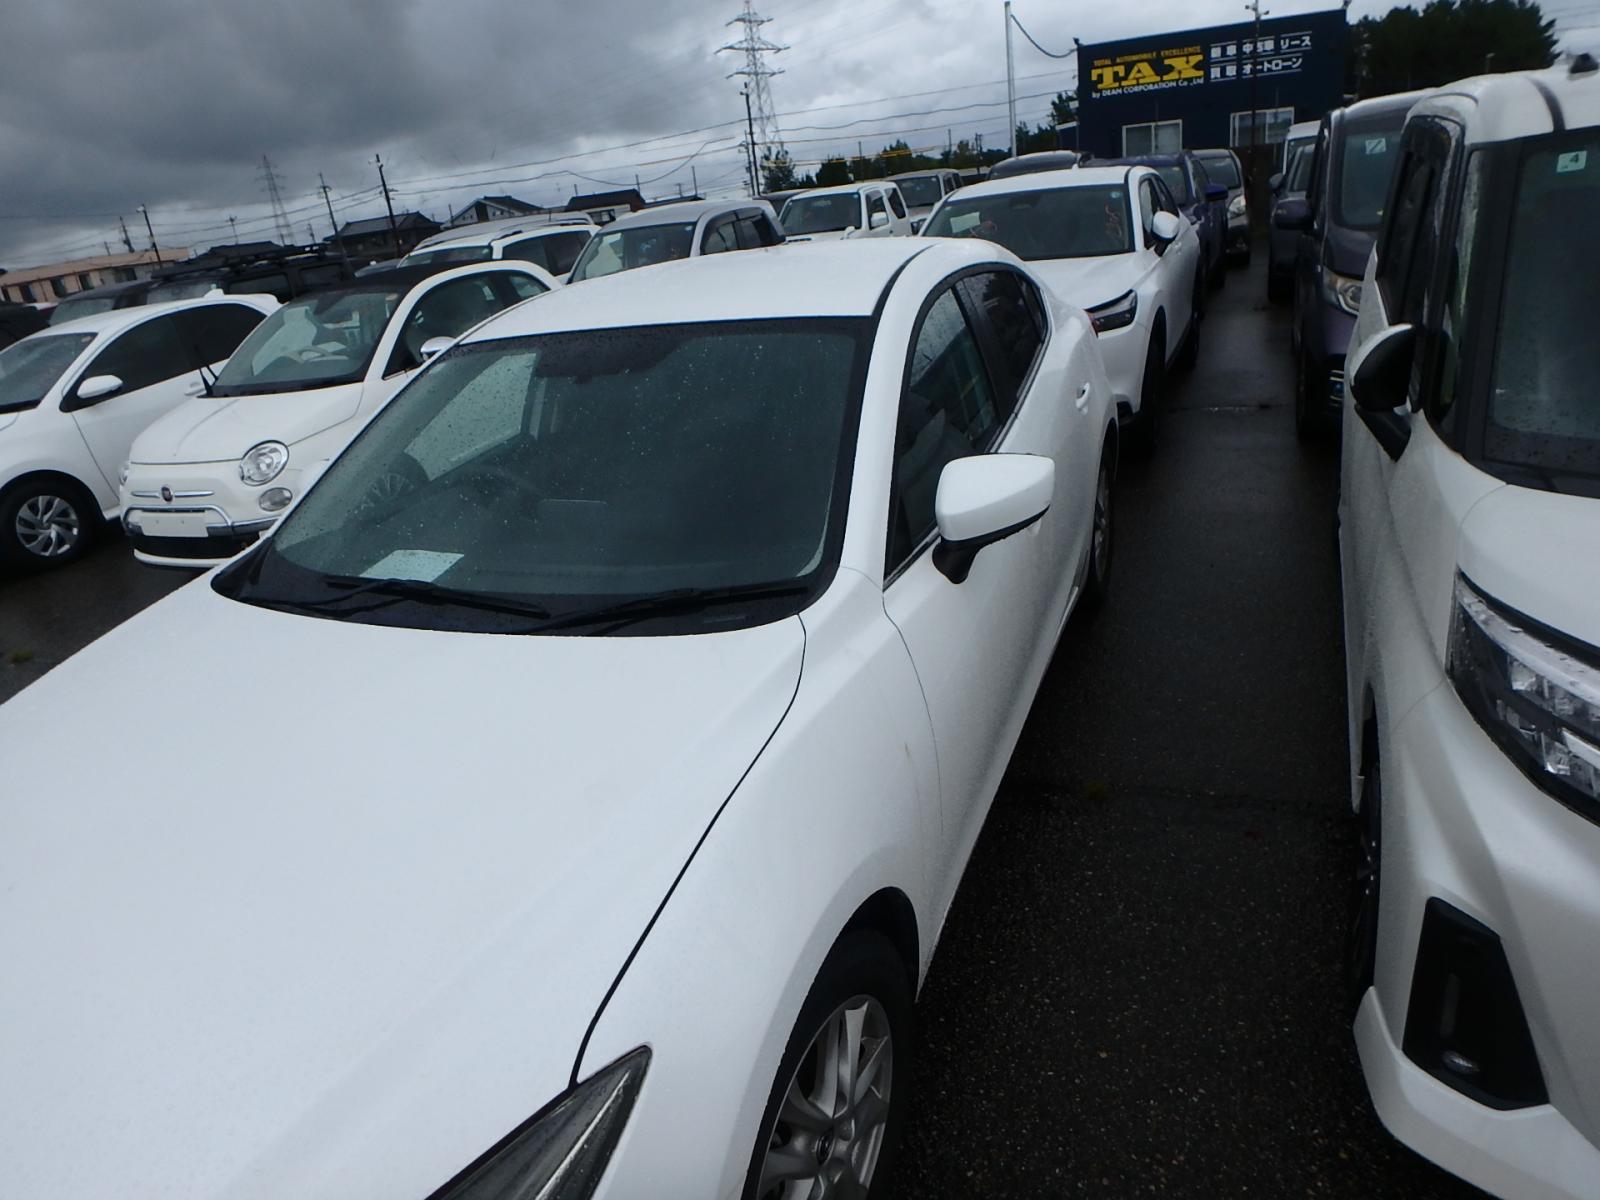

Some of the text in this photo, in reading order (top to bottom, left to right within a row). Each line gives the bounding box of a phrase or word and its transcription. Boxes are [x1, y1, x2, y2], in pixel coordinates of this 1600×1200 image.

[1280, 36, 1312, 49] リース
[1091, 54, 1205, 89] TAX
[1242, 57, 1303, 75] オートローン
[1102, 88, 1122, 97] DEAN
[1123, 80, 1177, 94] CORPORATION
